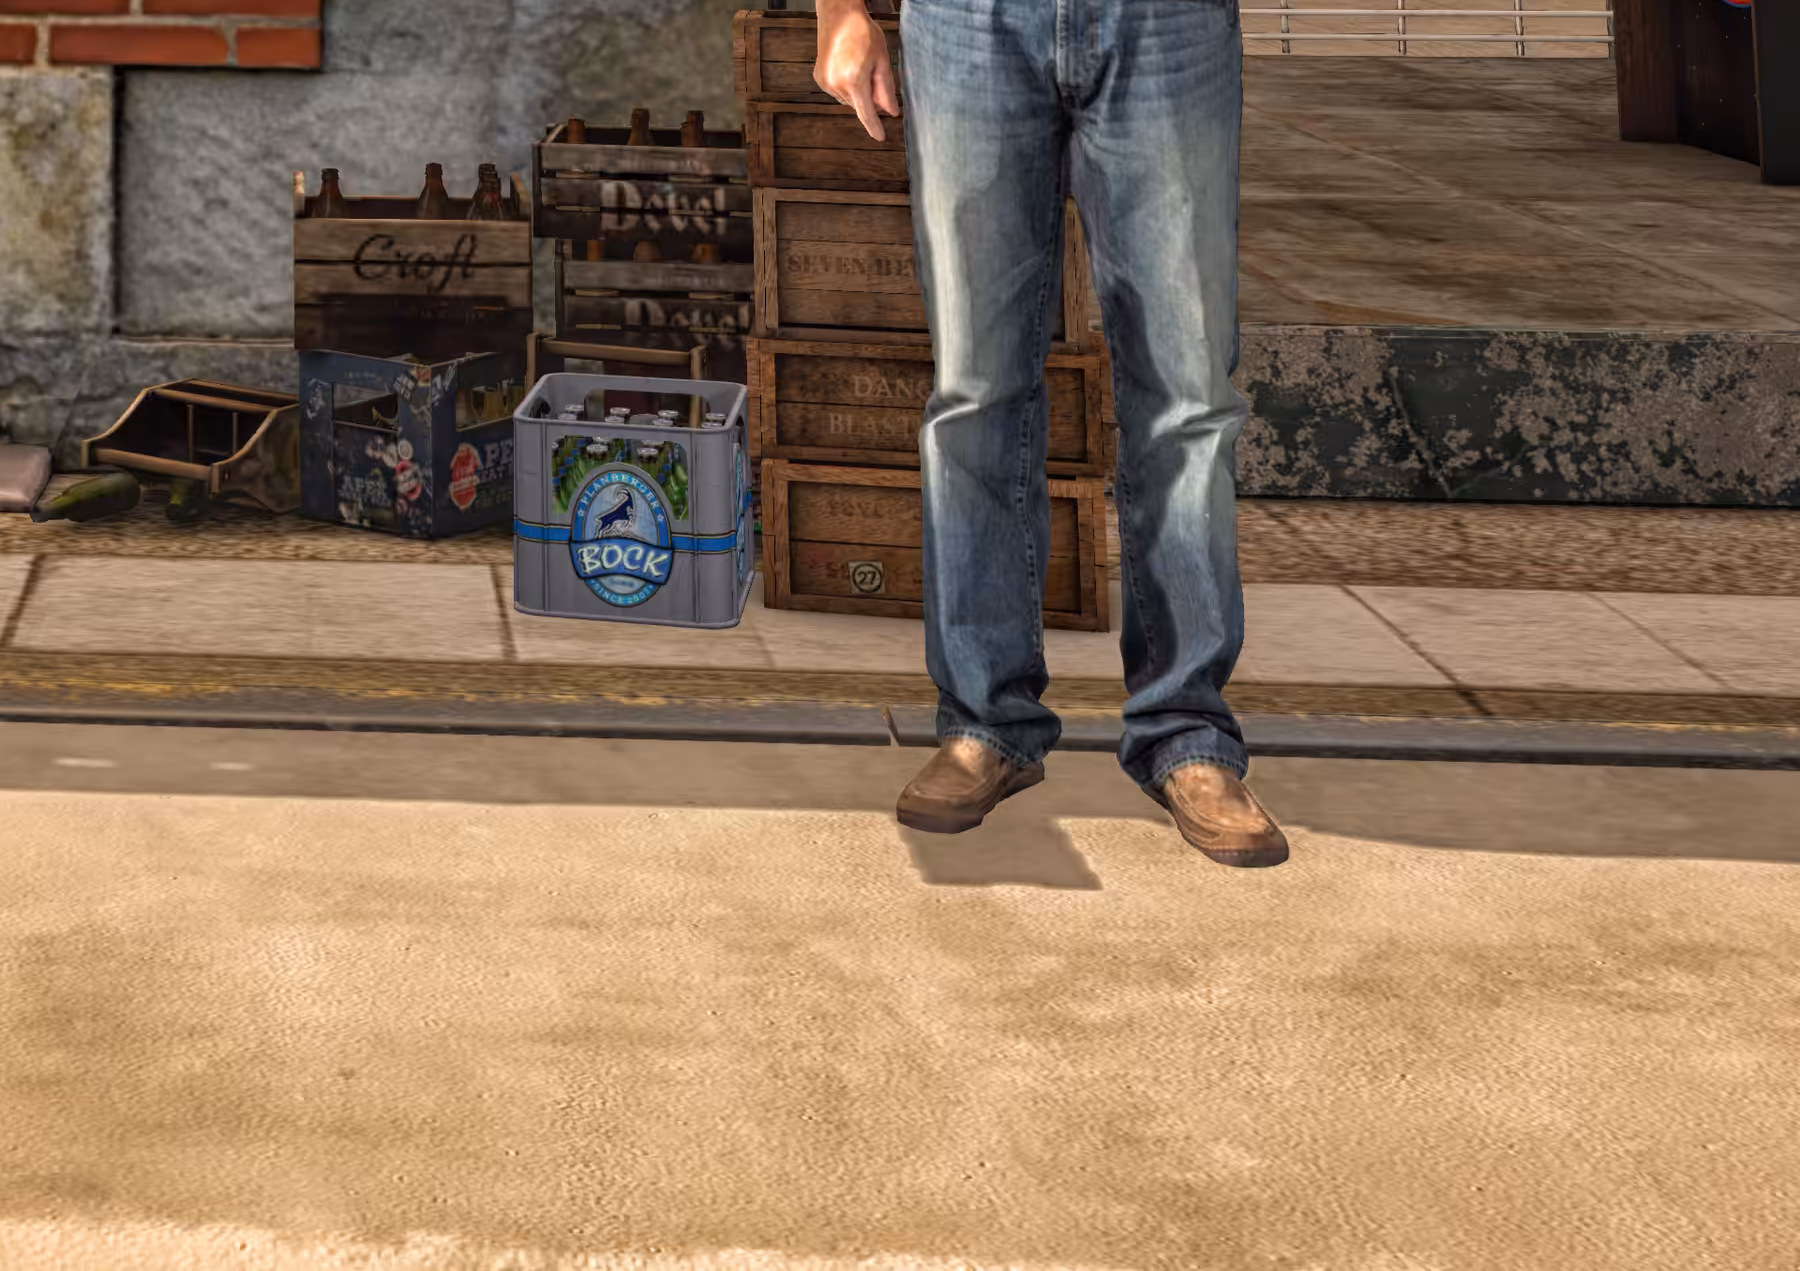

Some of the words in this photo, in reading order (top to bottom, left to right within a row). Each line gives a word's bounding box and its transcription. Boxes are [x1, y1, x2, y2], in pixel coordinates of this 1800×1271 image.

[353, 233, 478, 293] Croft
[576, 544, 669, 578] BOCK
[856, 570, 877, 586] 27
